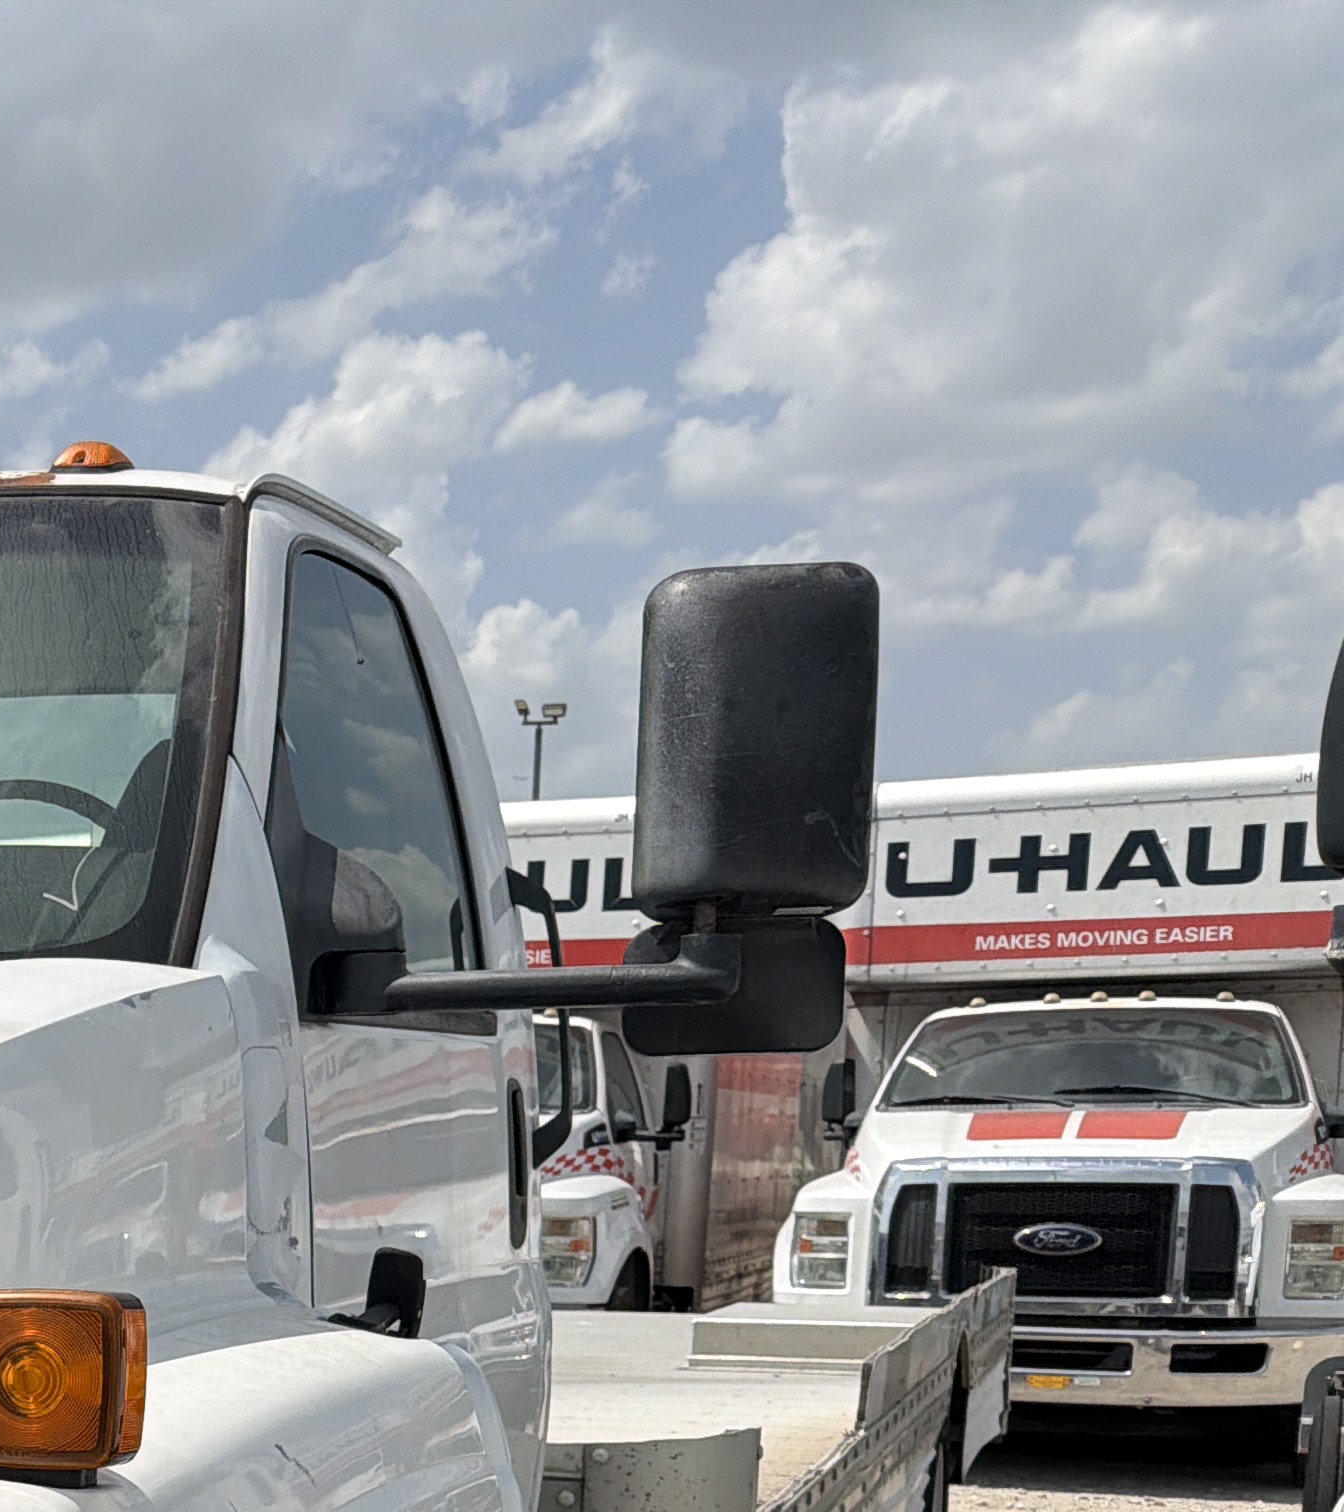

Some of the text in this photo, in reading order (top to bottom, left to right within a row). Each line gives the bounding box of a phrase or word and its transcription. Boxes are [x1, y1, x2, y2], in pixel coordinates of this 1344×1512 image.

[885, 821, 1343, 898] U-HAUL
[975, 925, 1234, 951] MAKES MOVING EASIER
